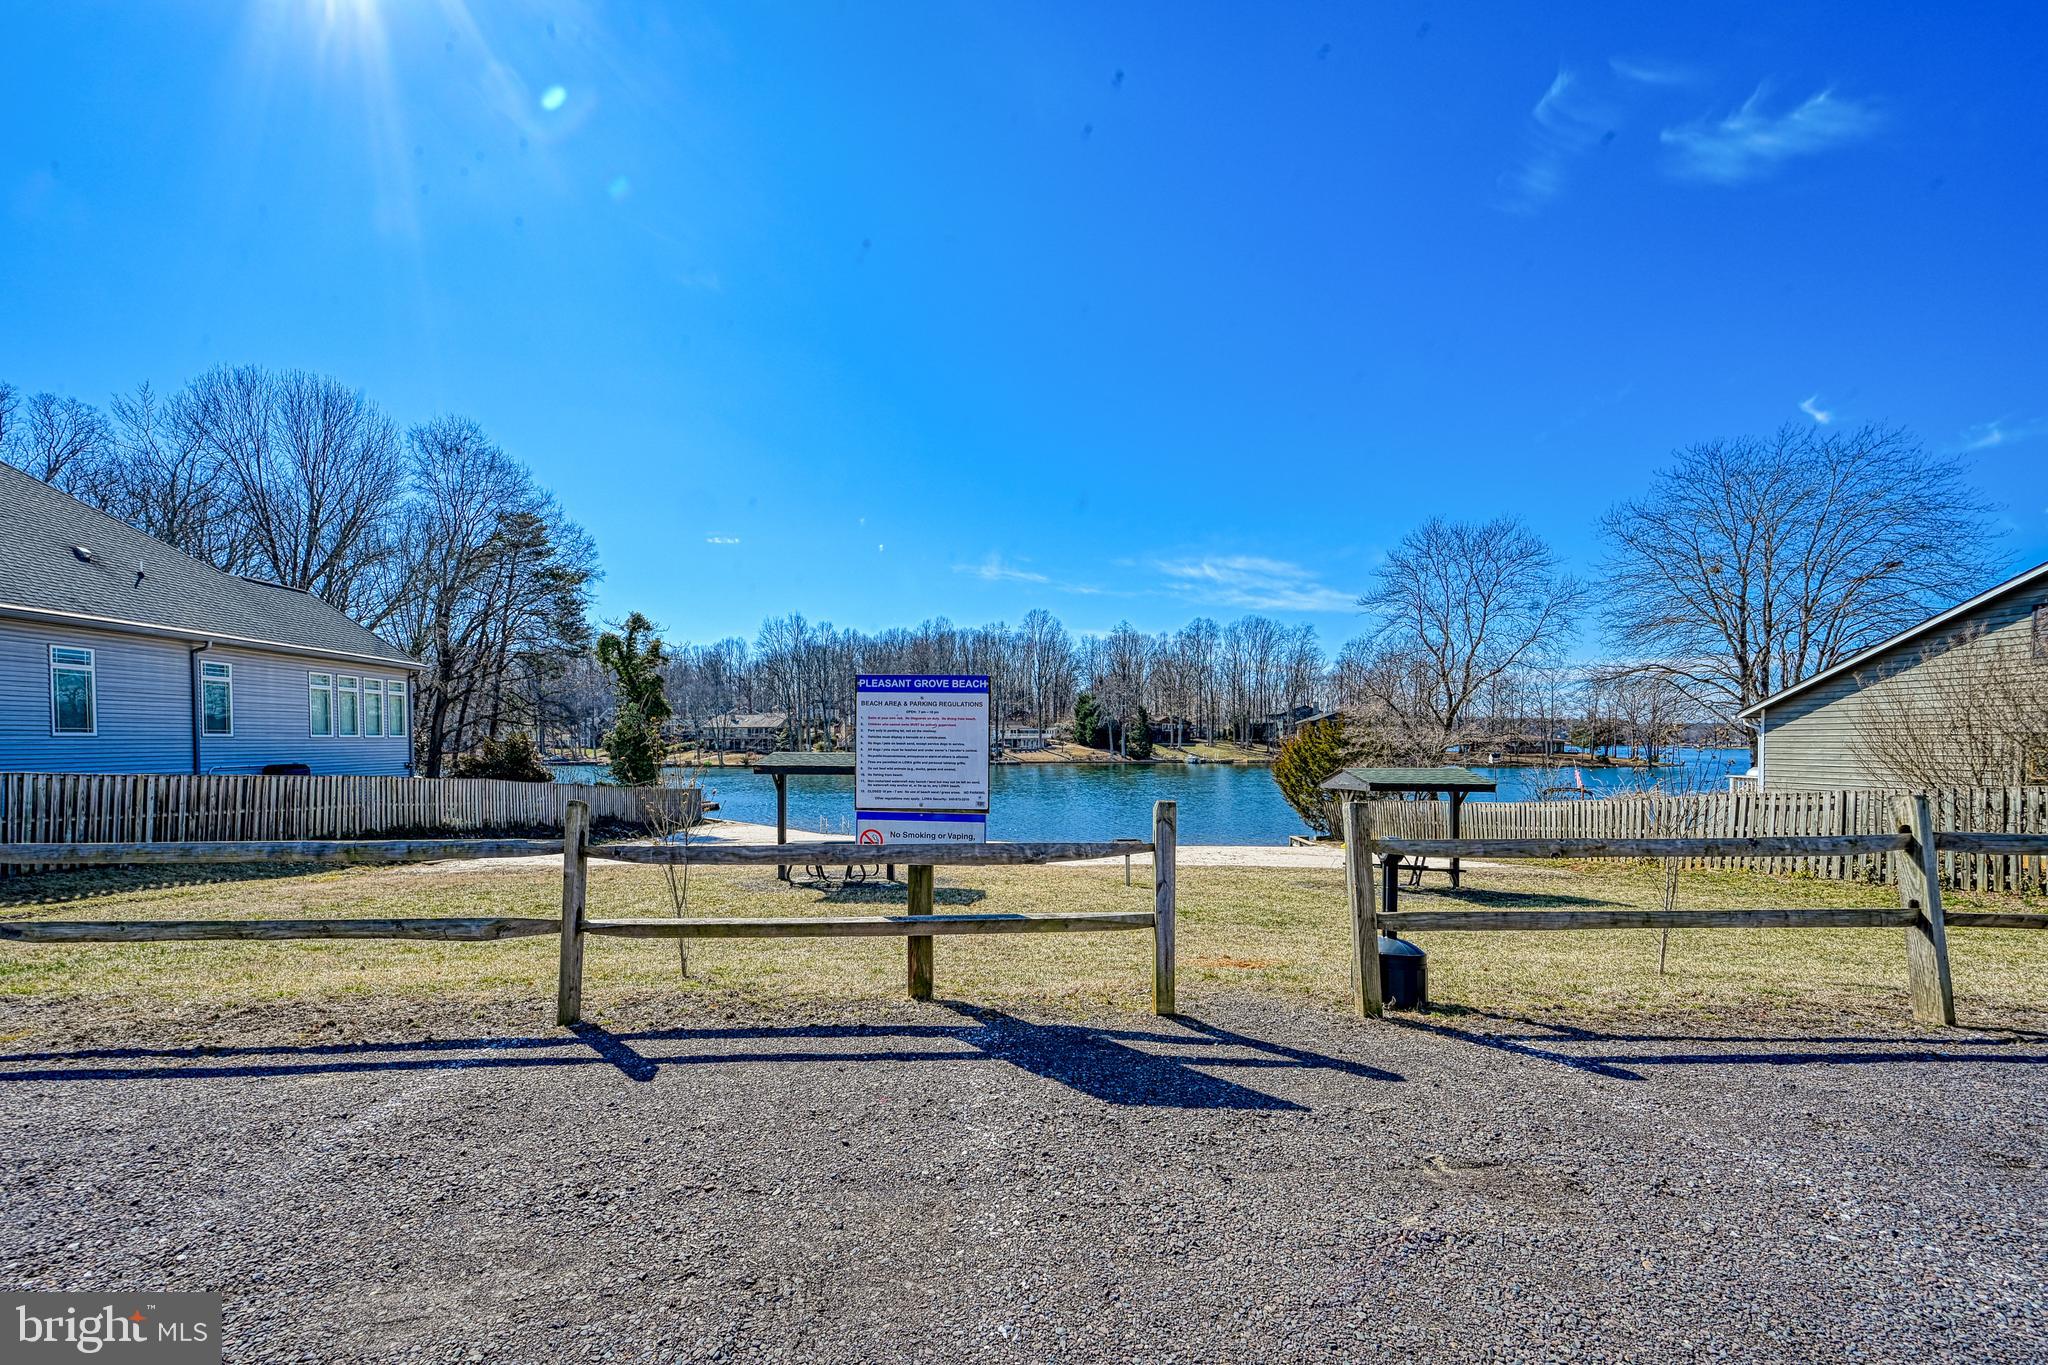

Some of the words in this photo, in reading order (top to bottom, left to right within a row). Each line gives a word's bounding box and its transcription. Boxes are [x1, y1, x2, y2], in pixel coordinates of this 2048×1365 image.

[859, 679, 911, 688] PLEASANT
[914, 680, 949, 688] GROVE
[903, 832, 936, 840] Smoking
[947, 832, 976, 840] Vaping,
